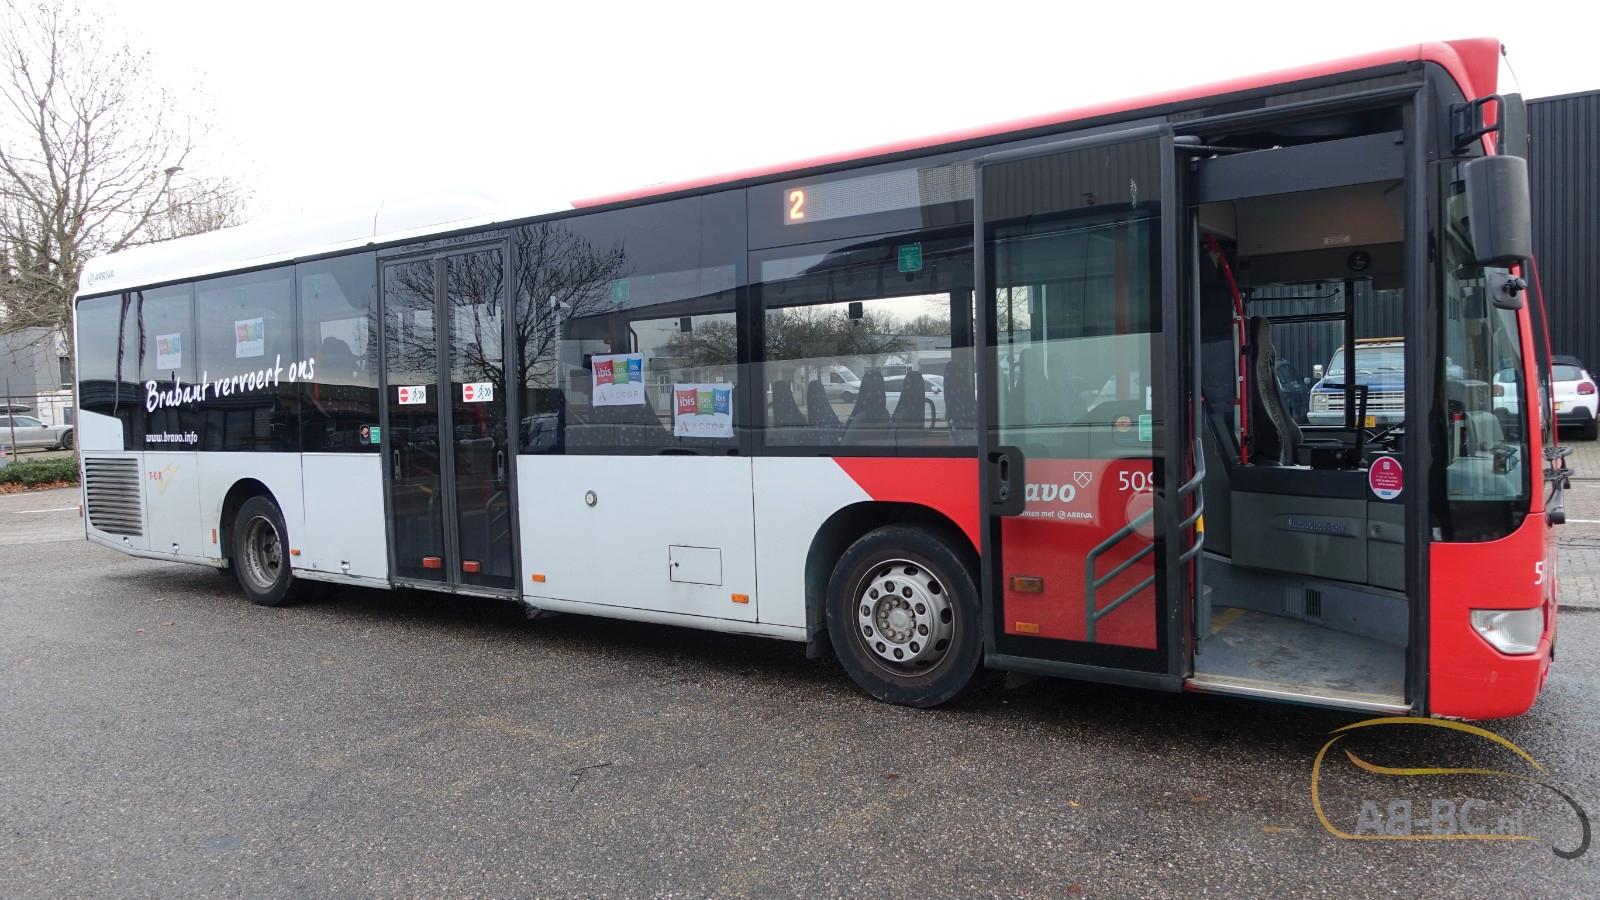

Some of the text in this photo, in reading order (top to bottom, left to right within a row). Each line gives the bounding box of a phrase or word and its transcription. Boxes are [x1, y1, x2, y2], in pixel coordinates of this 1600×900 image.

[789, 190, 805, 220] 2
[597, 366, 612, 378] ibis
[145, 353, 315, 413] Brabant vervoert ons
[679, 395, 695, 407] ibis
[145, 430, 198, 445] www.bravo.info
[1067, 511, 1093, 519] ARRIVA
